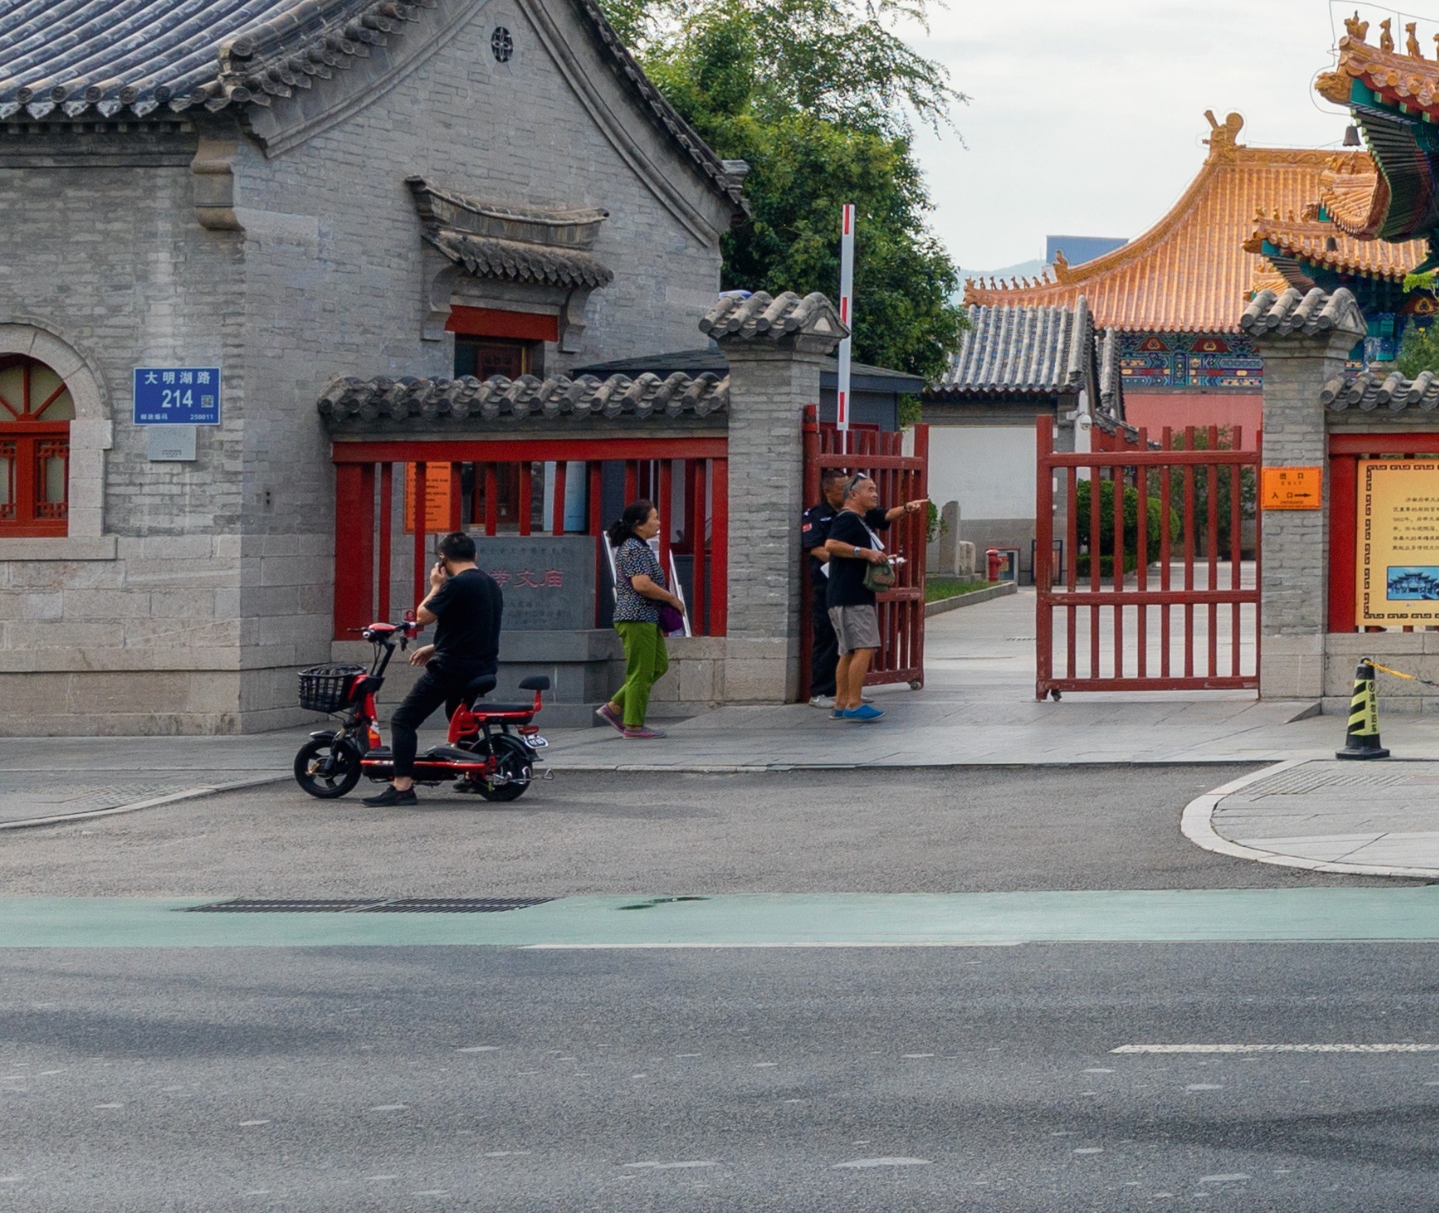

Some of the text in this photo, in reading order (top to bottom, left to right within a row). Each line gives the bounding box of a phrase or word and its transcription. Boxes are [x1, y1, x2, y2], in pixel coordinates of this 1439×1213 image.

[144, 371, 211, 384] 大明湖路
[161, 389, 193, 408] 214
[1279, 472, 1304, 480] 出口
